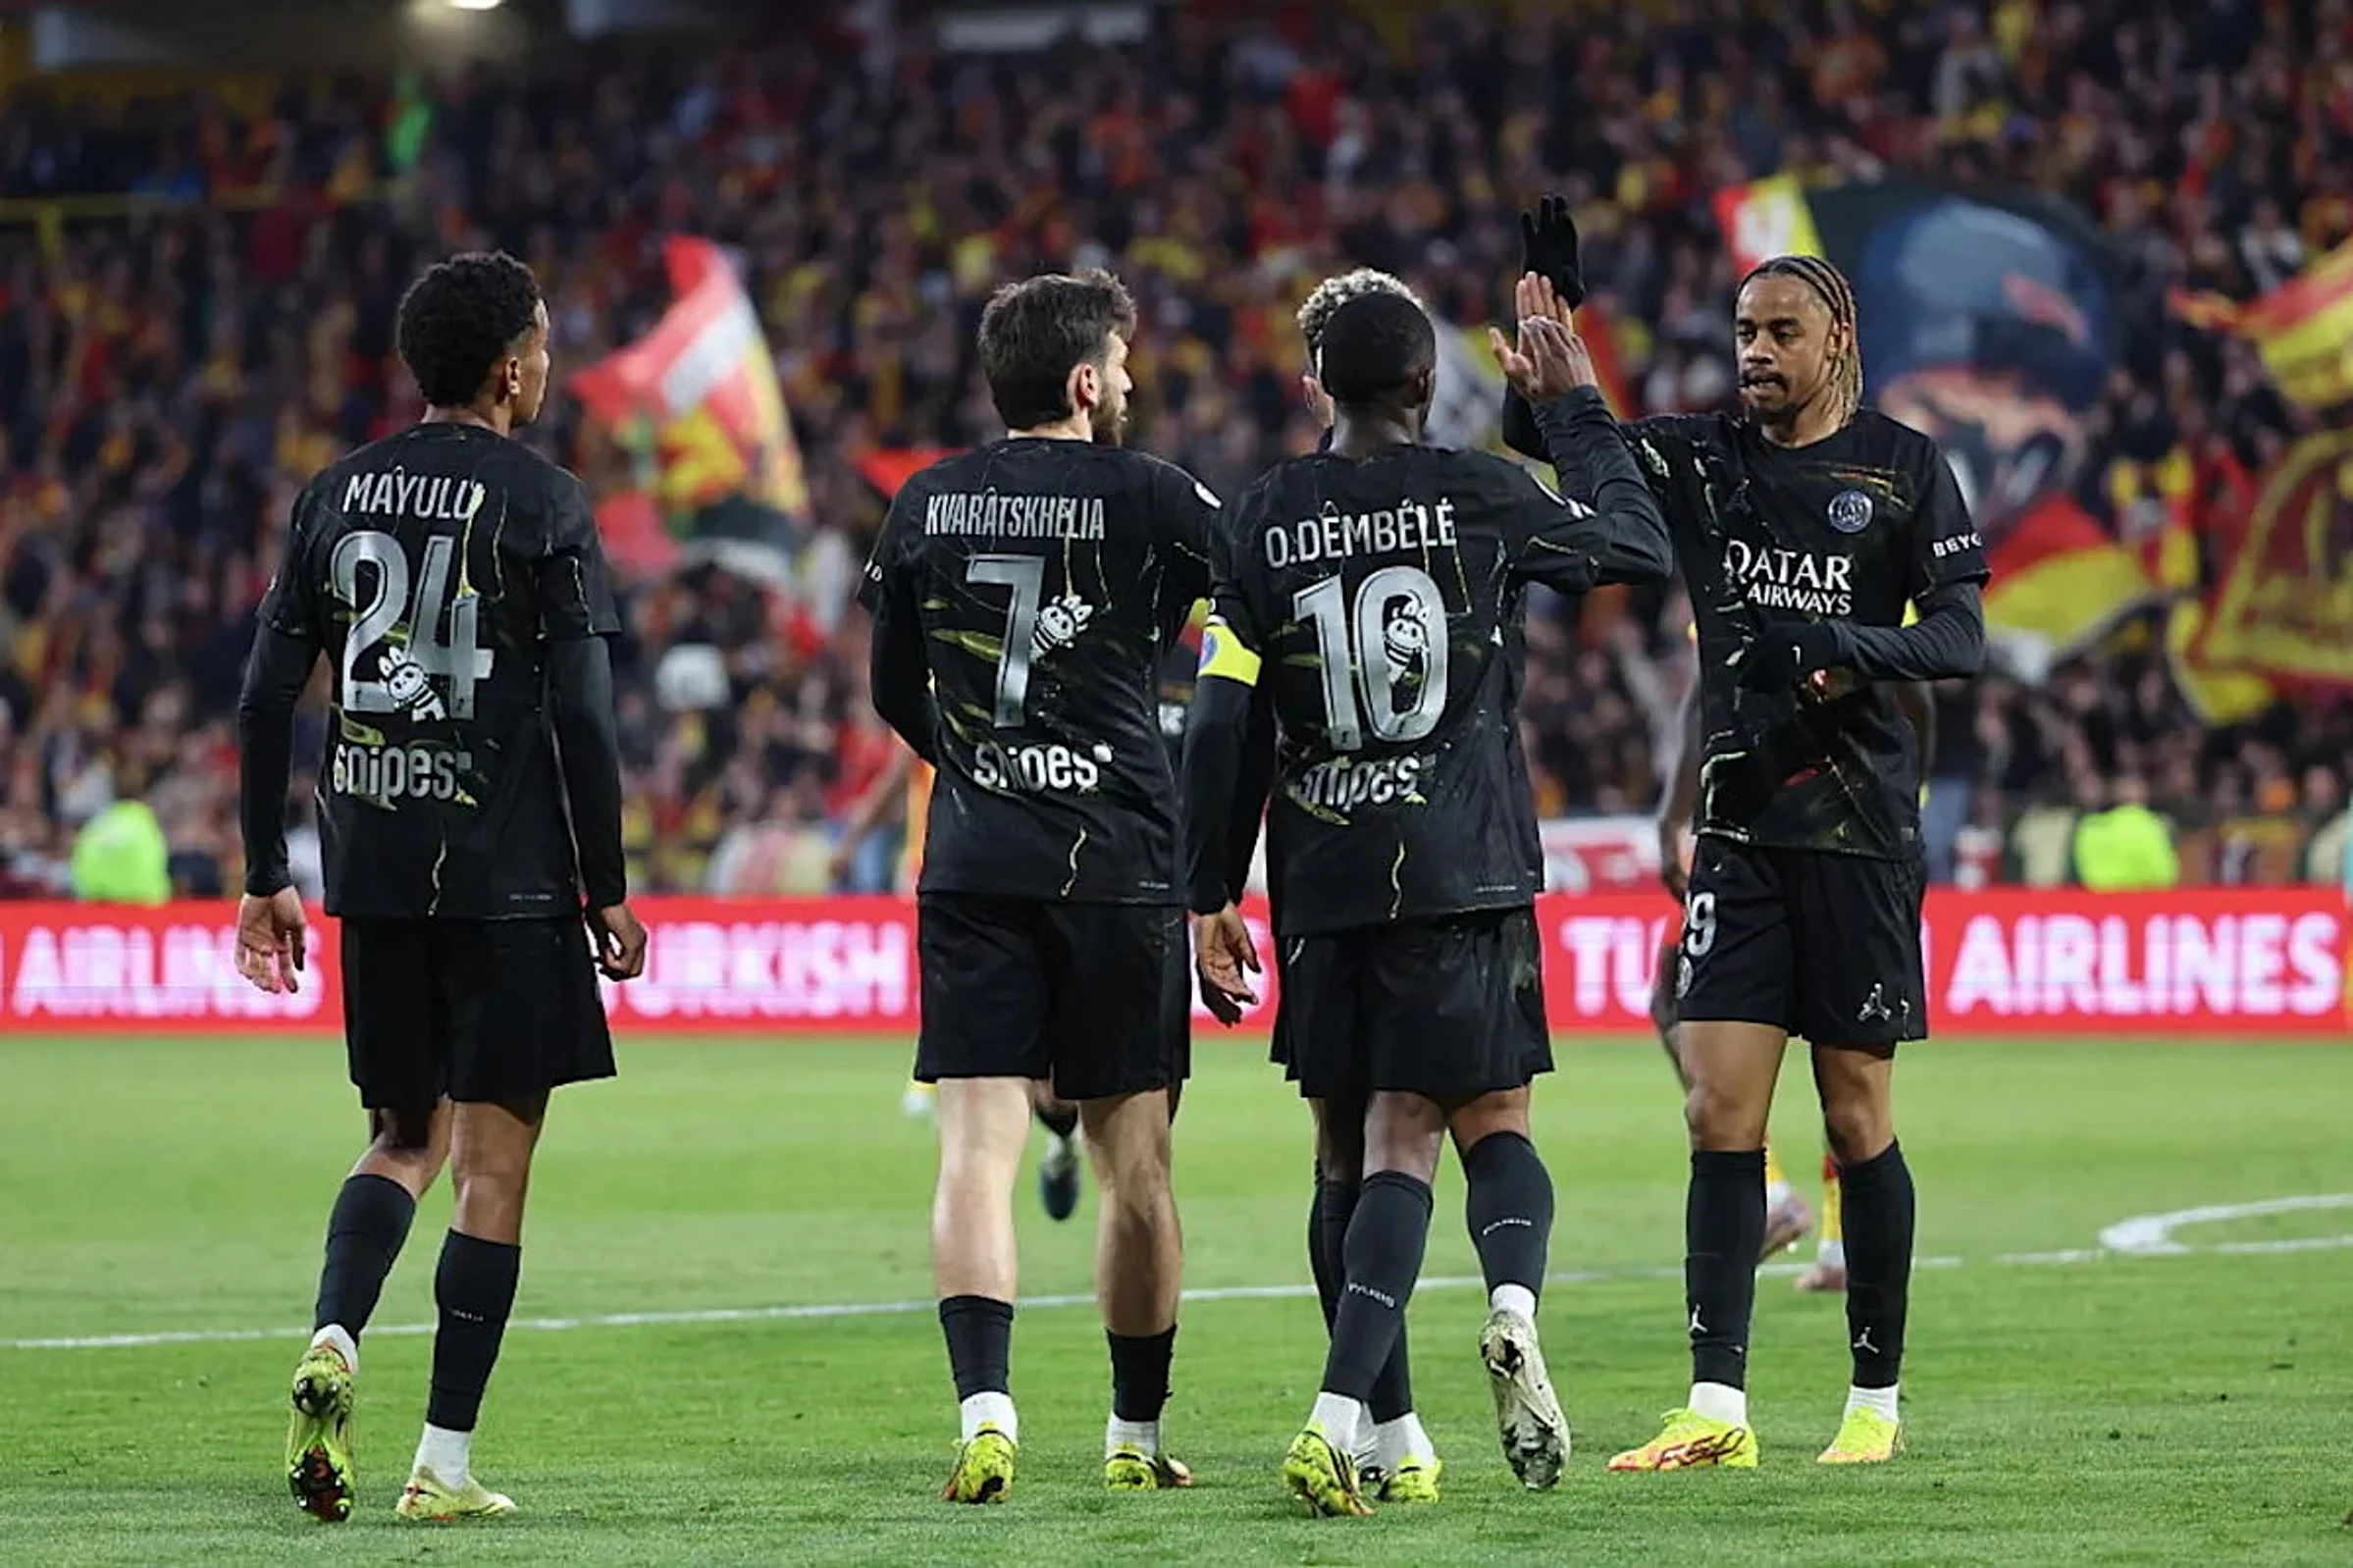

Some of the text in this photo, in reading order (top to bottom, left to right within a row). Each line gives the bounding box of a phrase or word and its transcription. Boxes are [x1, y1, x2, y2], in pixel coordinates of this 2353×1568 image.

[924, 492, 1106, 541] KVARATSKHELIA
[1722, 539, 1853, 592] QATAR
[330, 528, 495, 720] 24
[966, 553, 1046, 728] 7
[1747, 581, 1853, 616] AIRWAYS
[1291, 564, 1449, 753] 10
[595, 920, 908, 1018] URKISH
[1946, 912, 2341, 1017] AIRLINES
